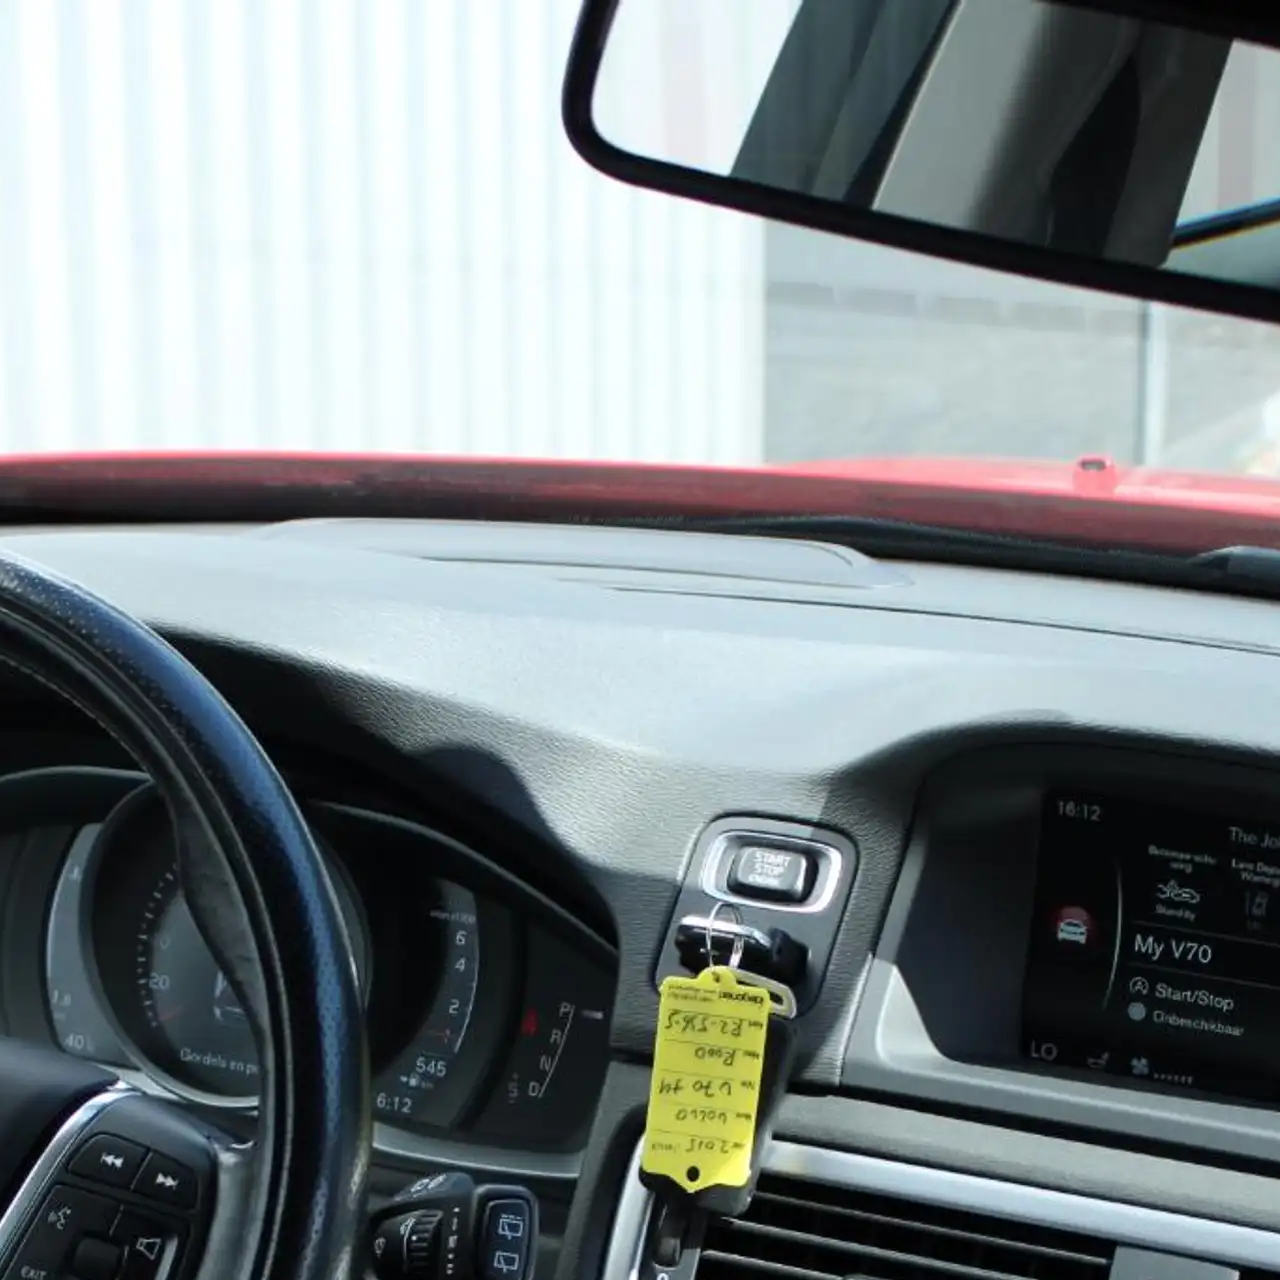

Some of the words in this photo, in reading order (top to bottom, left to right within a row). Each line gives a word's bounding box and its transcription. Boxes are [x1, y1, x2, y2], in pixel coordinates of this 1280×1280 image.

[1057, 799, 1101, 823] 16:12
[1229, 826, 1257, 848] The
[753, 850, 791, 867] START
[753, 862, 784, 876] STOP
[454, 930, 468, 946] 6
[1133, 933, 1164, 960] My
[1171, 938, 1213, 964] V70
[454, 957, 468, 973] 4
[149, 973, 170, 990] 20
[1154, 981, 1236, 1013] Start/Stop
[447, 998, 460, 1015] 2
[558, 1001, 572, 1017] P
[1029, 1040, 1058, 1062] LO
[415, 1056, 448, 1078] 545
[539, 1054, 552, 1072] N
